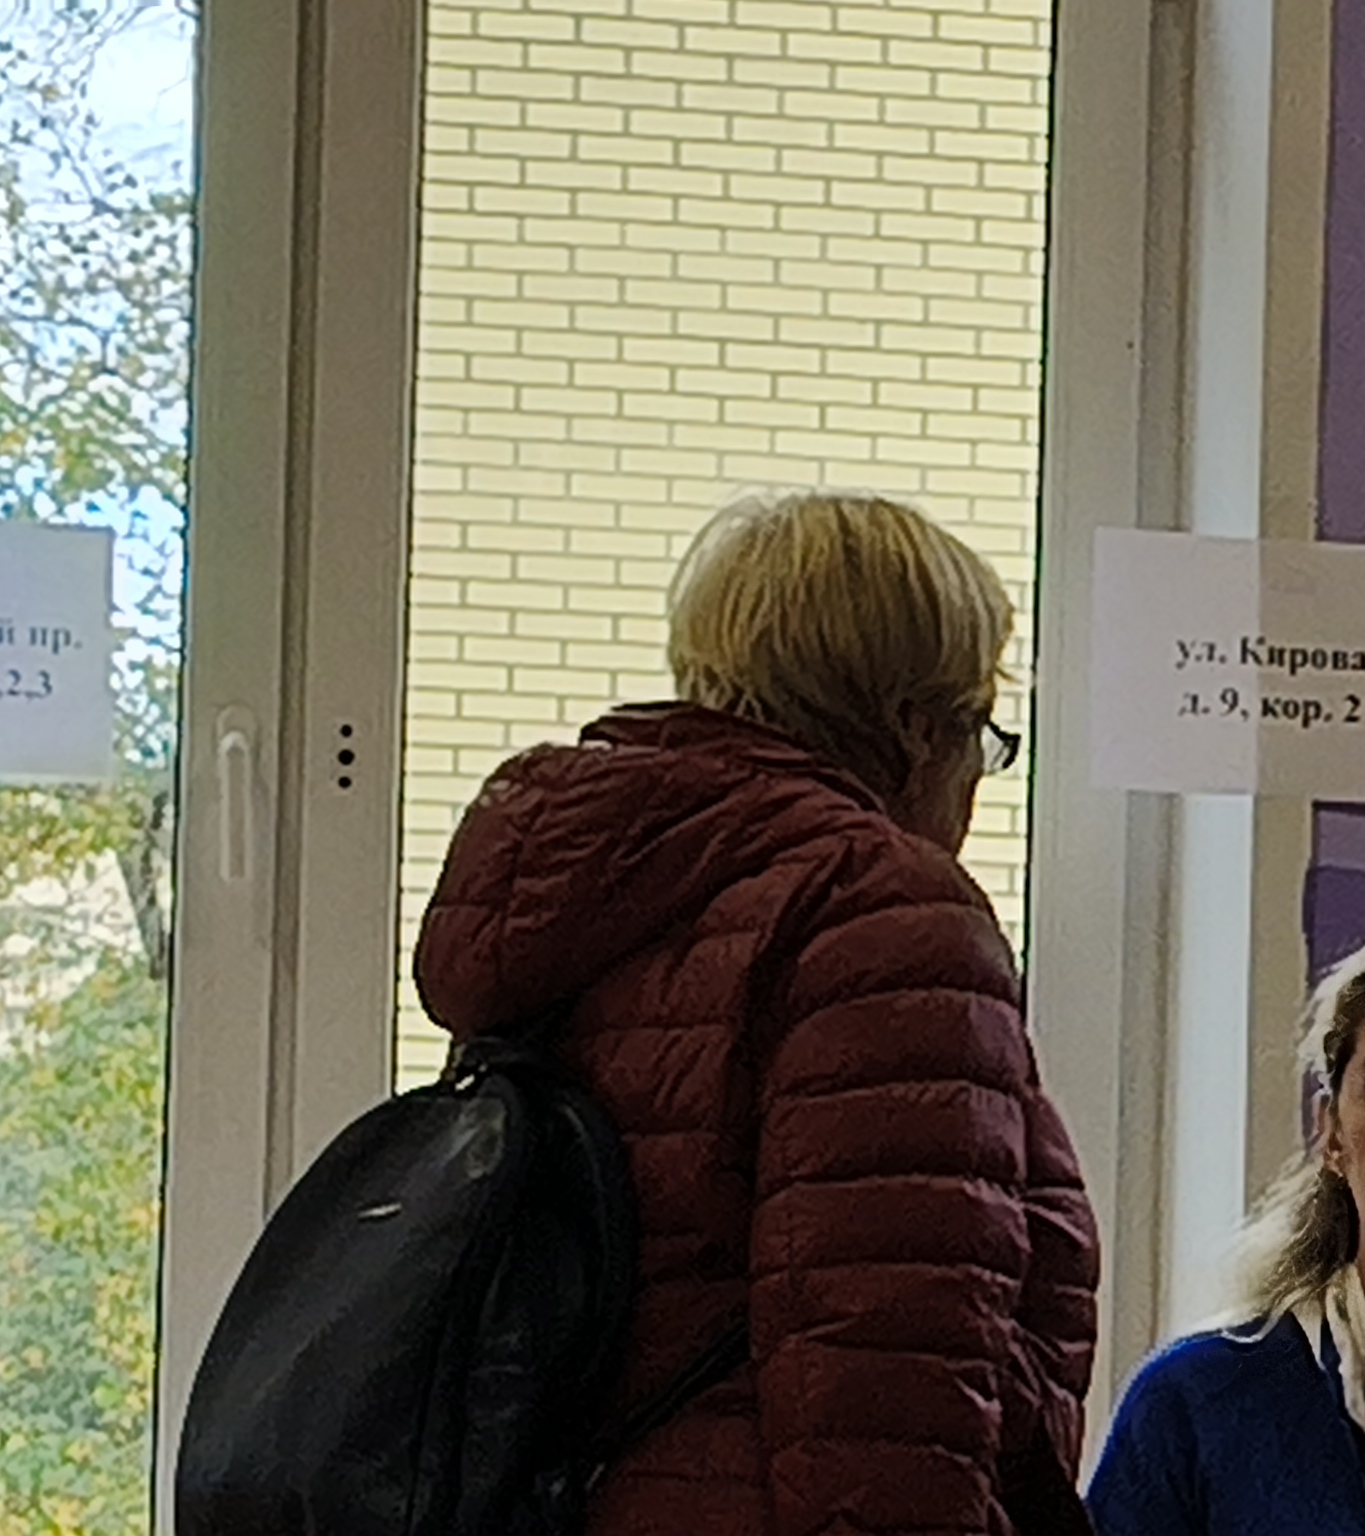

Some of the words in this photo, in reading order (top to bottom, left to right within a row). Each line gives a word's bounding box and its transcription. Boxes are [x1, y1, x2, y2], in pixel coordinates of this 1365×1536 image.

[28, 624, 83, 655] пр.
[1175, 638, 1227, 669] ул.
[1178, 692, 1211, 717] д.
[1218, 688, 1250, 721] 9,
[1260, 695, 1333, 729] кор.
[1343, 694, 1362, 723] 2
